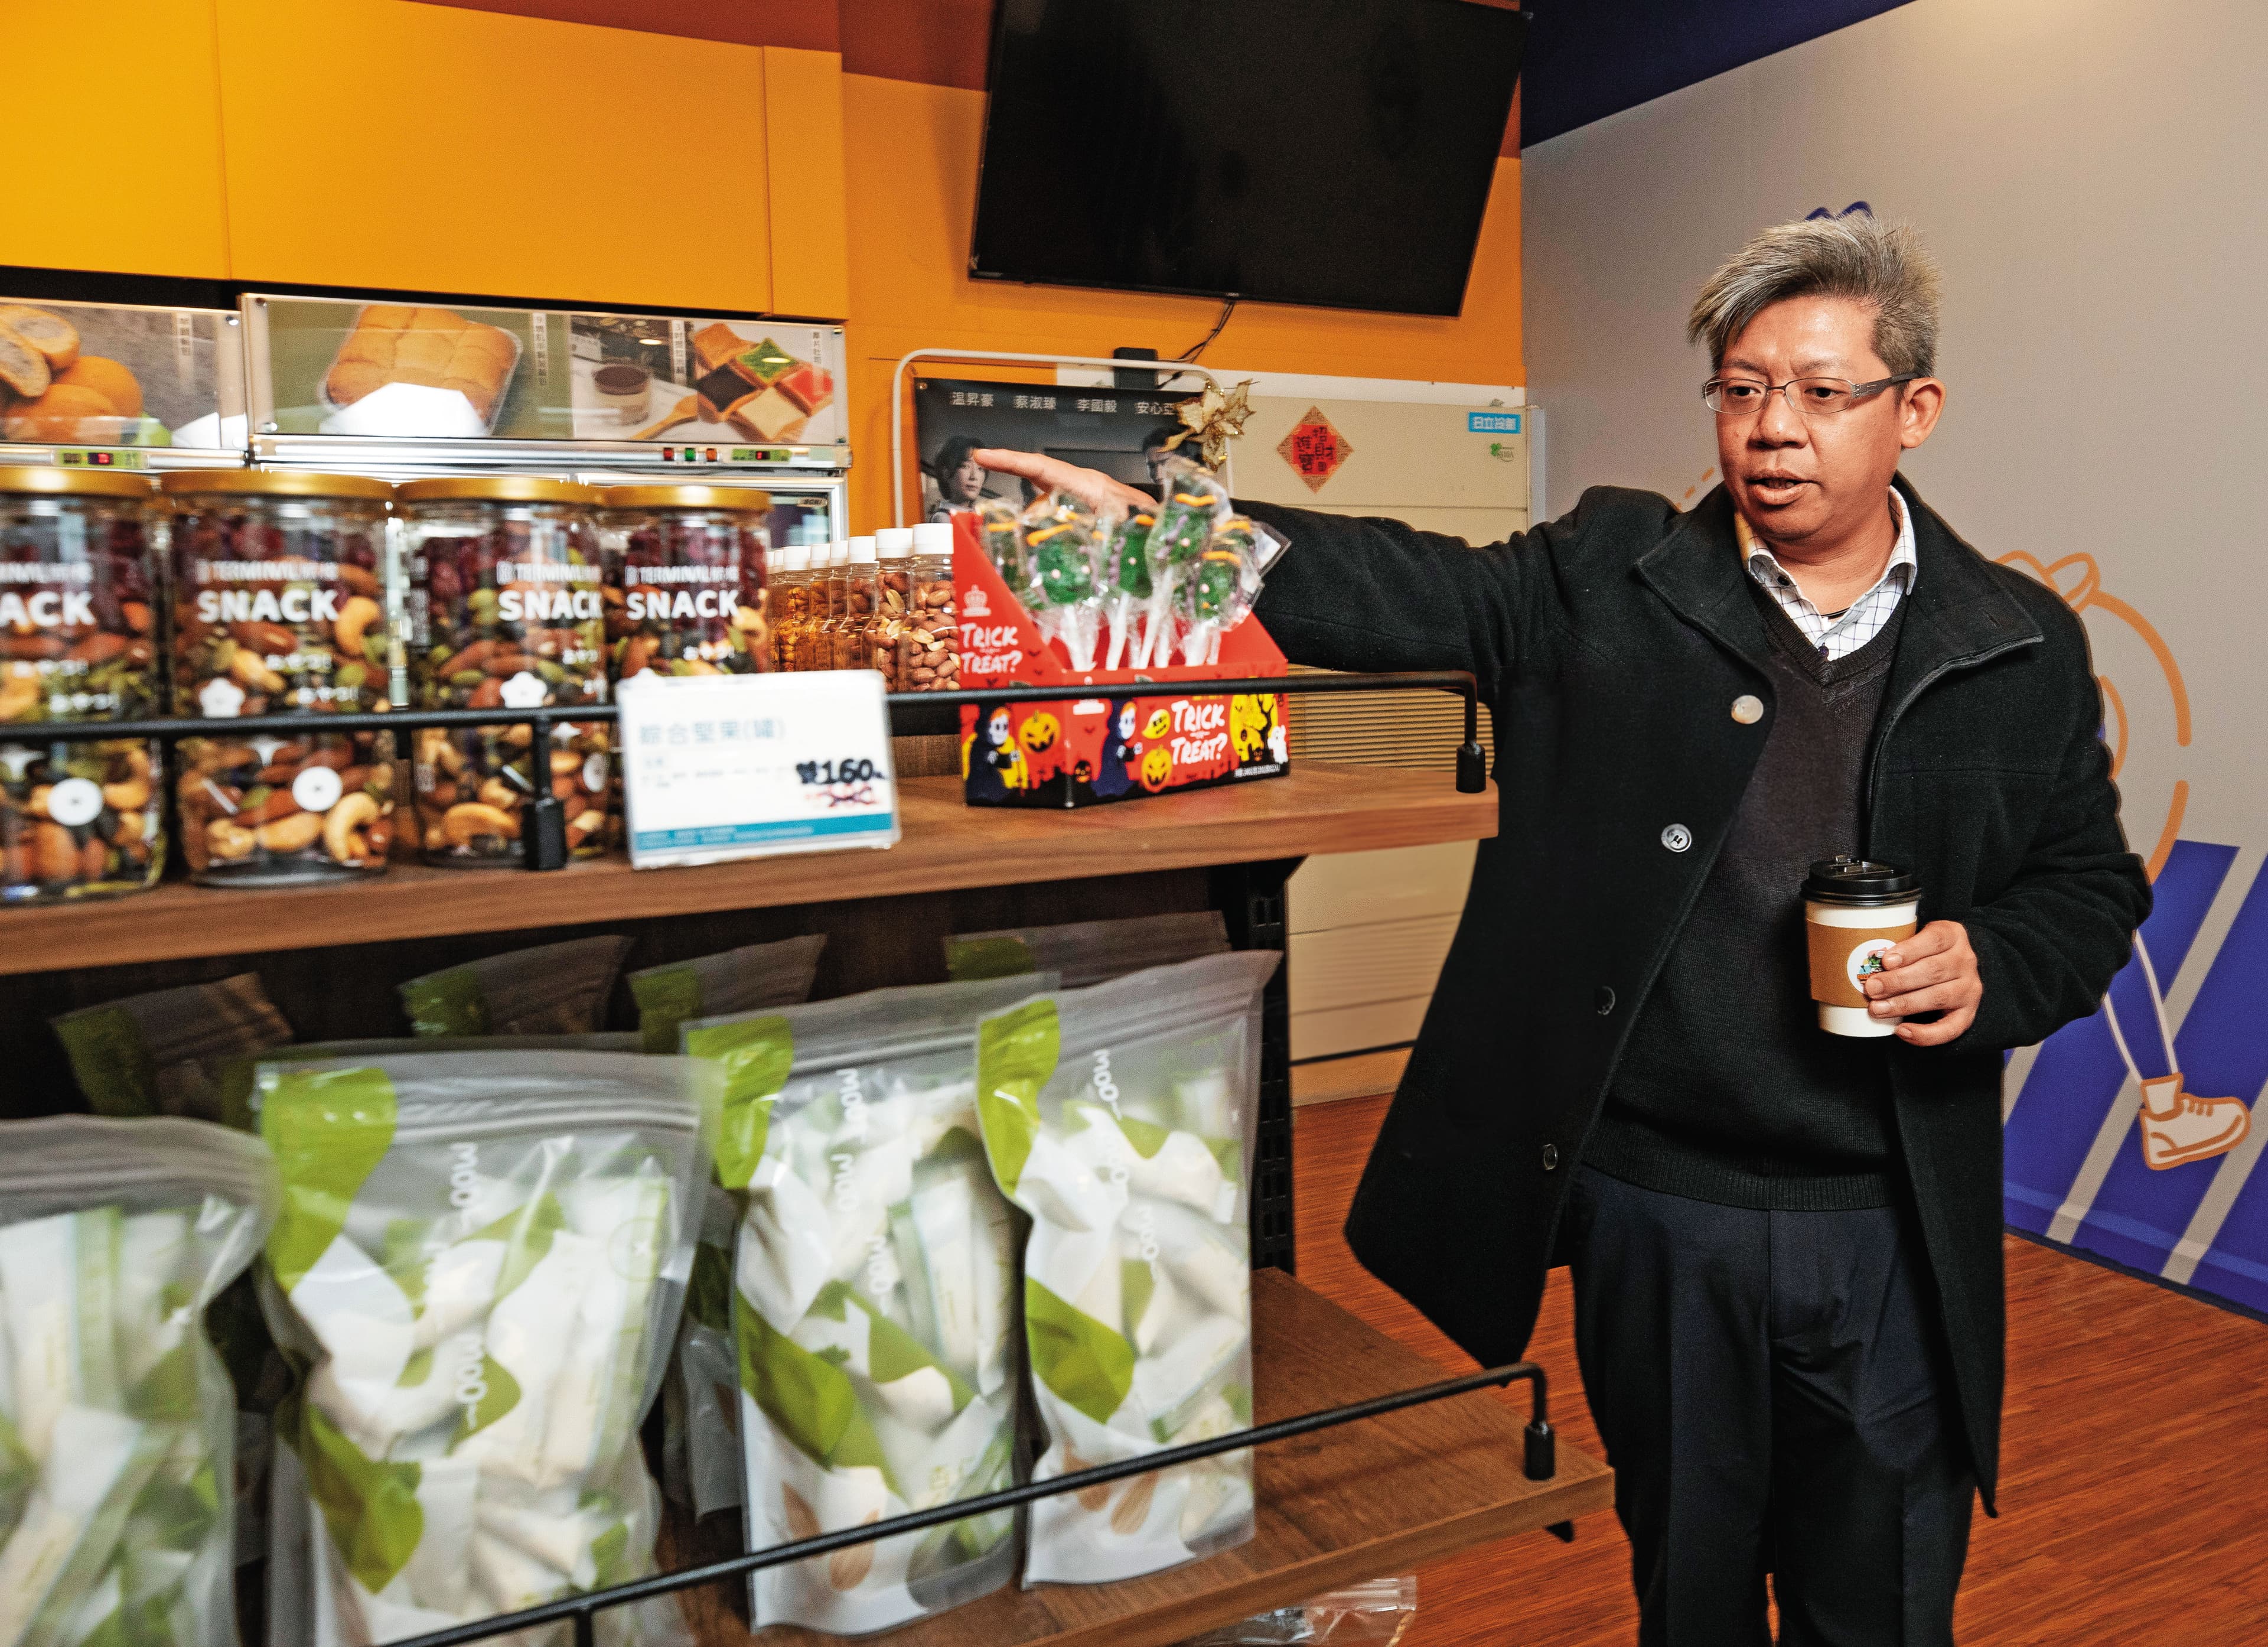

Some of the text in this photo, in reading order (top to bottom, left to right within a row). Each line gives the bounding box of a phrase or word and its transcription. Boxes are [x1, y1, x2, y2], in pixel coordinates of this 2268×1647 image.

[197, 588, 340, 623] SNACK
[625, 589, 739, 621] SNACK
[960, 623, 1018, 649] TRICK
[960, 650, 1023, 674] TREAT?
[1171, 699, 1226, 733] TRICK
[1170, 733, 1228, 766] TREAT?
